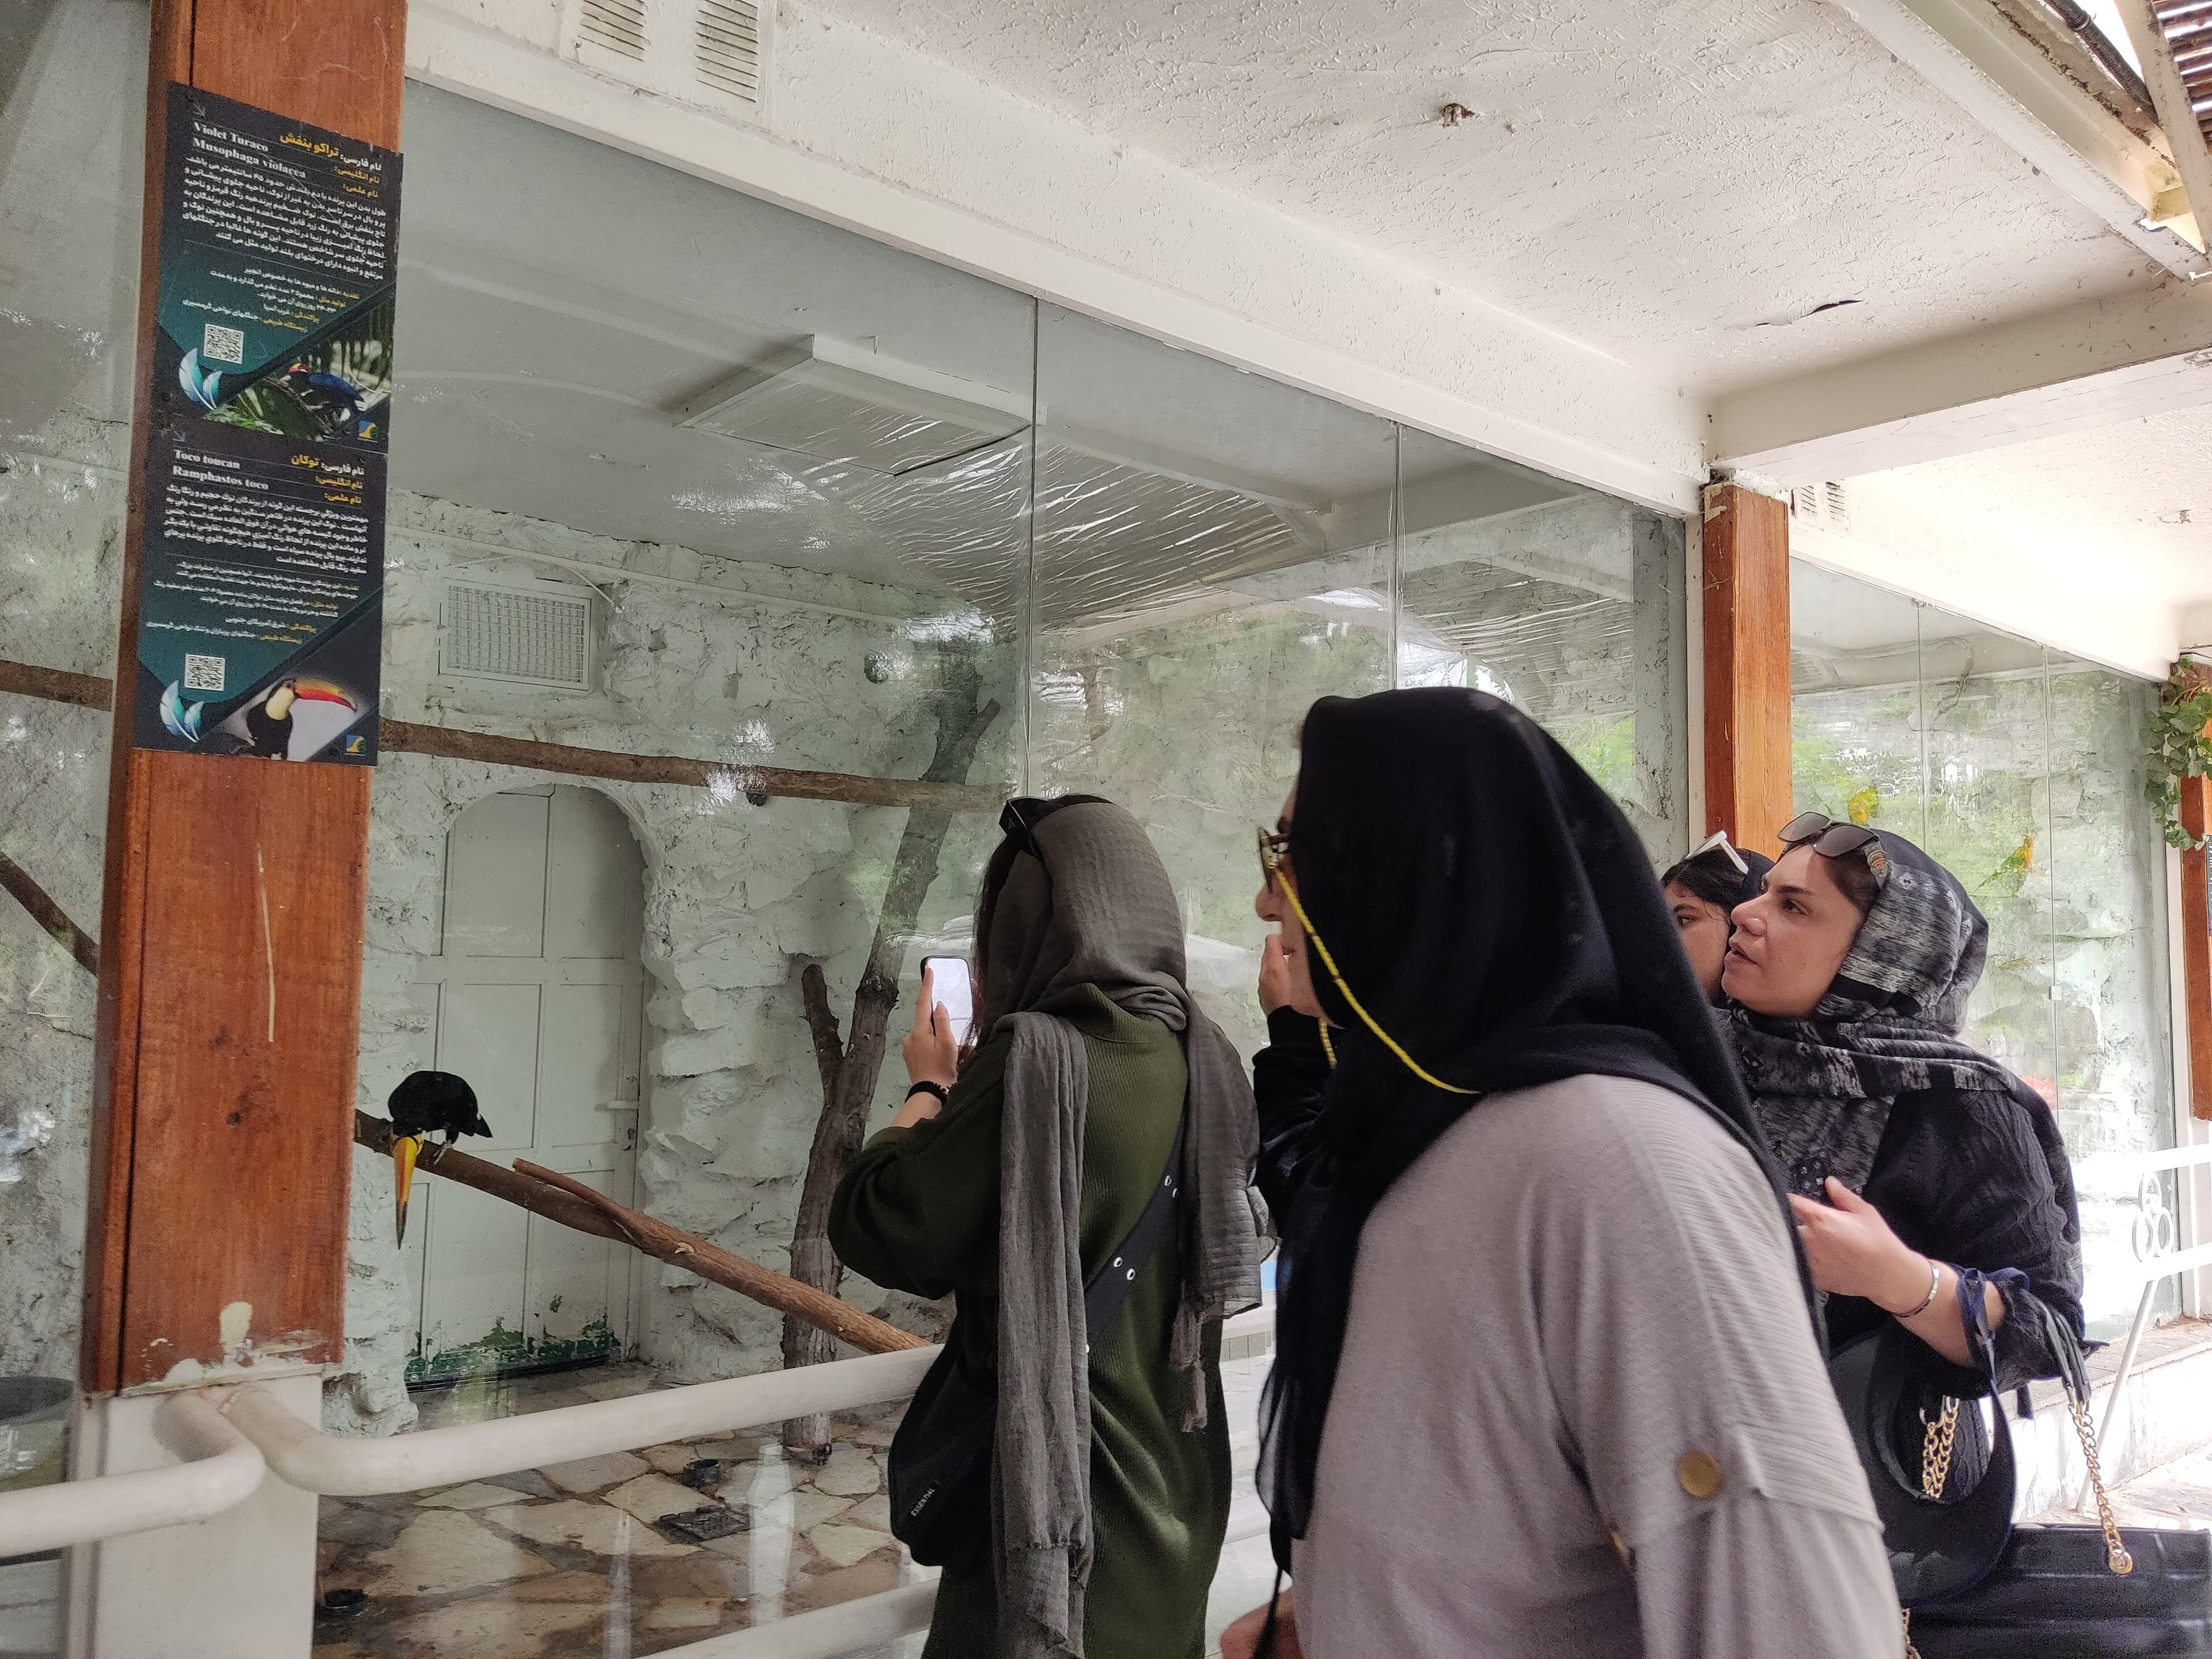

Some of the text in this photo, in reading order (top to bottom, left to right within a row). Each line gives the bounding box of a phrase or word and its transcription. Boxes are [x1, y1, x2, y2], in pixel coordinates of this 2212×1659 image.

[194, 121, 268, 152] Violet Turaco
[279, 132, 312, 151] بنفش
[193, 137, 259, 165] Musophaga
[369, 162, 382, 171] نام
[368, 176, 380, 184] نام
[367, 190, 378, 198] نام
[345, 200, 358, 209] این
[173, 448, 201, 462] Toco
[351, 466, 365, 476] نام
